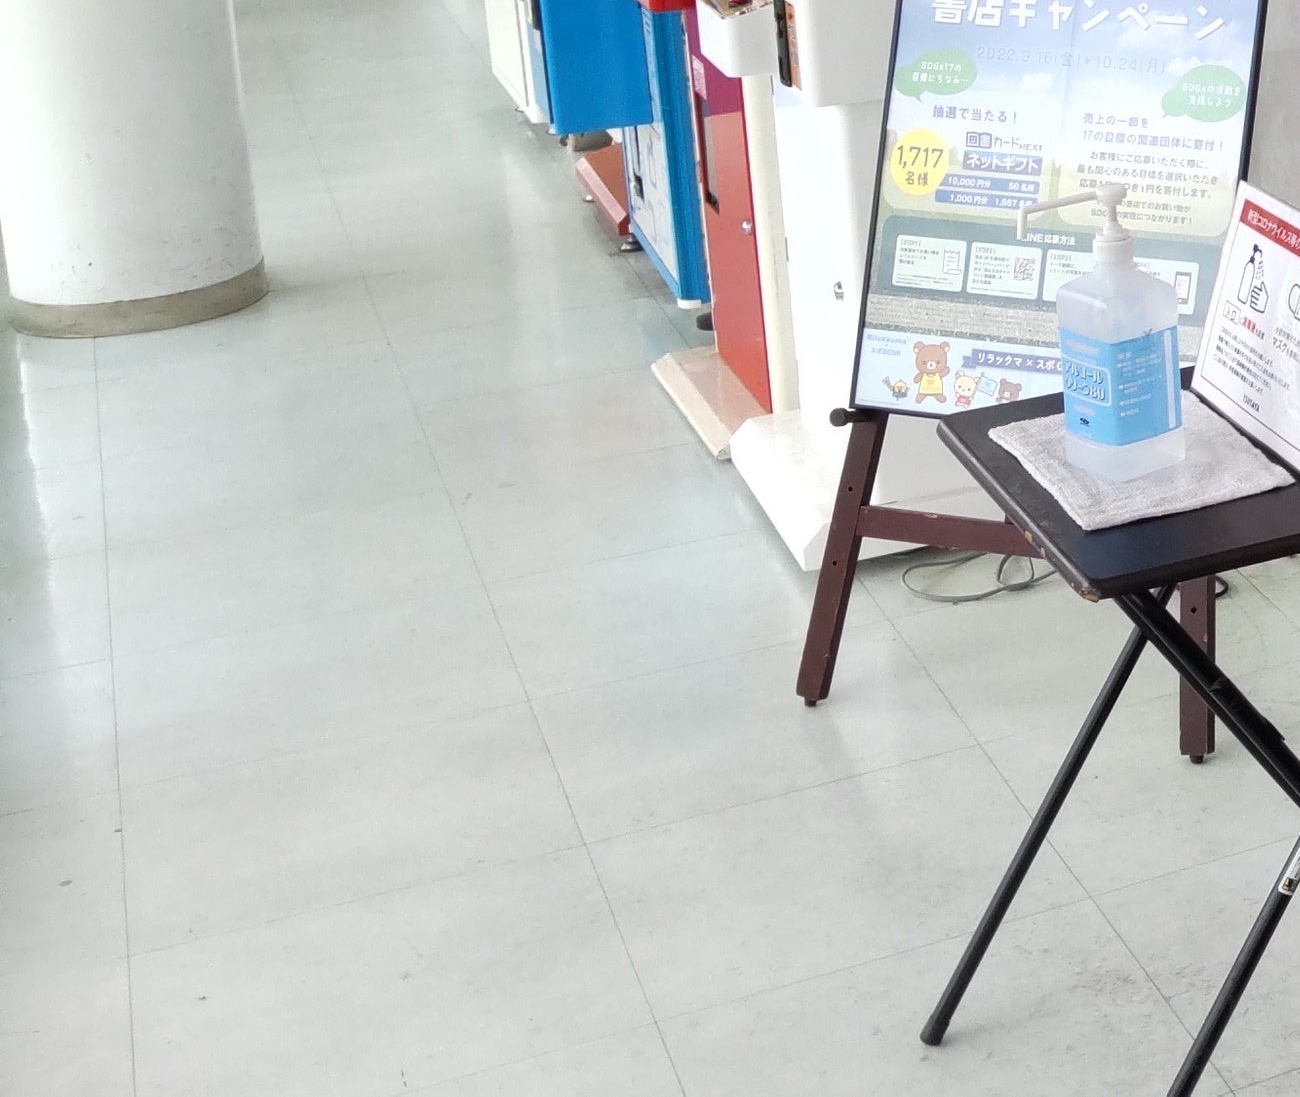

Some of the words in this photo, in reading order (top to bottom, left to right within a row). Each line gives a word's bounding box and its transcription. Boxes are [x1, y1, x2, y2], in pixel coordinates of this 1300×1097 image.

[897, 145, 944, 169] 1,717
[966, 154, 1039, 173] ネットギフト
[905, 171, 929, 186] 名様
[978, 352, 1022, 367] リラックマ
